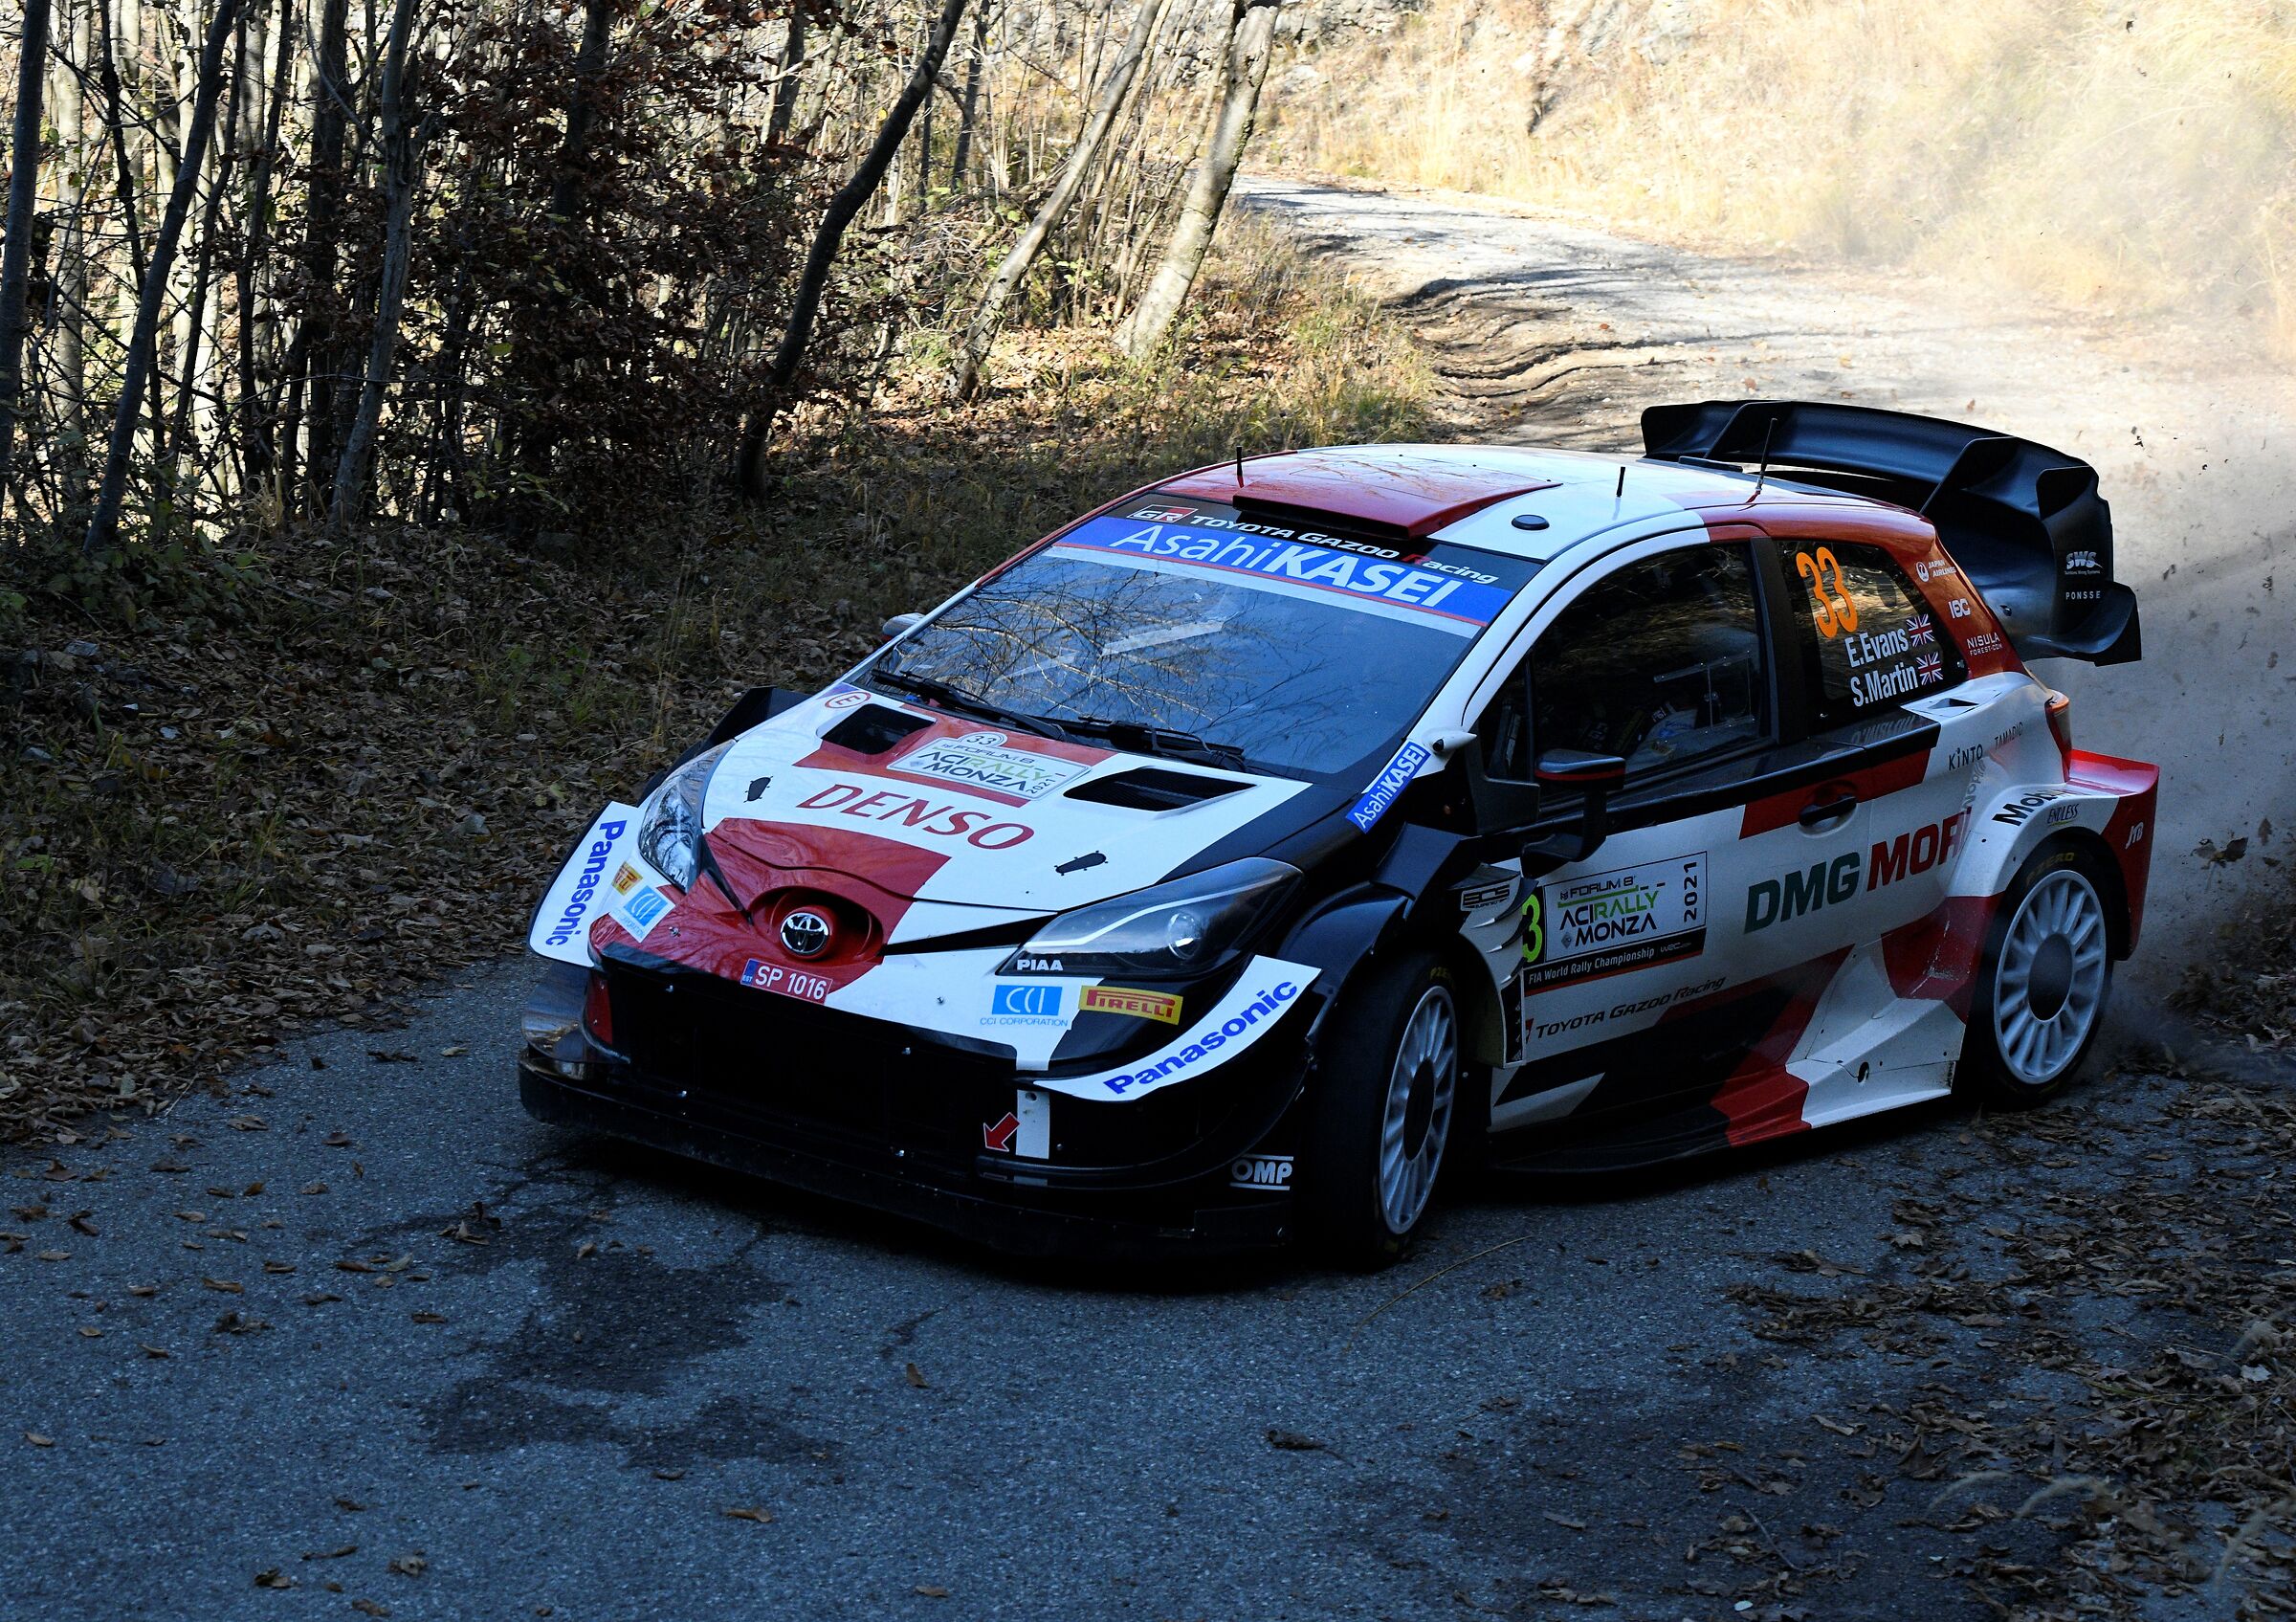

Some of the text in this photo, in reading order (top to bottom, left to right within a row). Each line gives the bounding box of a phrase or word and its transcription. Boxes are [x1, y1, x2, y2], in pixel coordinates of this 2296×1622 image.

[1110, 524, 1464, 608] AsahiKASEI
[1190, 515, 1500, 586] TOYOTA GAZOO Racing
[1928, 559, 1946, 569] JAPAN
[2065, 550, 2098, 569] SWS
[1932, 567, 1957, 578] AIRLINES
[1795, 546, 1858, 638] 33
[2065, 590, 2101, 600] PONSSE
[1844, 627, 1910, 668] E.Evans
[1966, 632, 2000, 649] NISULA
[1849, 661, 1919, 707] S.Martin
[966, 735, 997, 745] 33
[923, 763, 1027, 791] MONZA
[1026, 778, 1056, 794] 2021
[1354, 744, 1426, 829] AsahiKASEI
[796, 784, 1035, 850] DENSO
[546, 820, 628, 946] Panasonic
[1570, 878, 1621, 899] FORUM
[1684, 861, 1698, 922] 2021
[1744, 852, 1861, 934] DMG
[1575, 913, 1657, 947] MONZA
[1017, 959, 1064, 971] PIAA
[1529, 945, 1655, 985] FIA World Rally Championship
[755, 966, 828, 1000] SP 1016
[1086, 989, 1177, 1018] PIRELLI
[1535, 1011, 1605, 1038] TOYOTA
[1609, 993, 1672, 1019] GAZOO
[1674, 976, 1727, 1001] Racing
[980, 1017, 1069, 1027] CCI CORPORATION
[1103, 981, 1298, 1094] Panasonic
[1231, 1159, 1292, 1184] OMP
